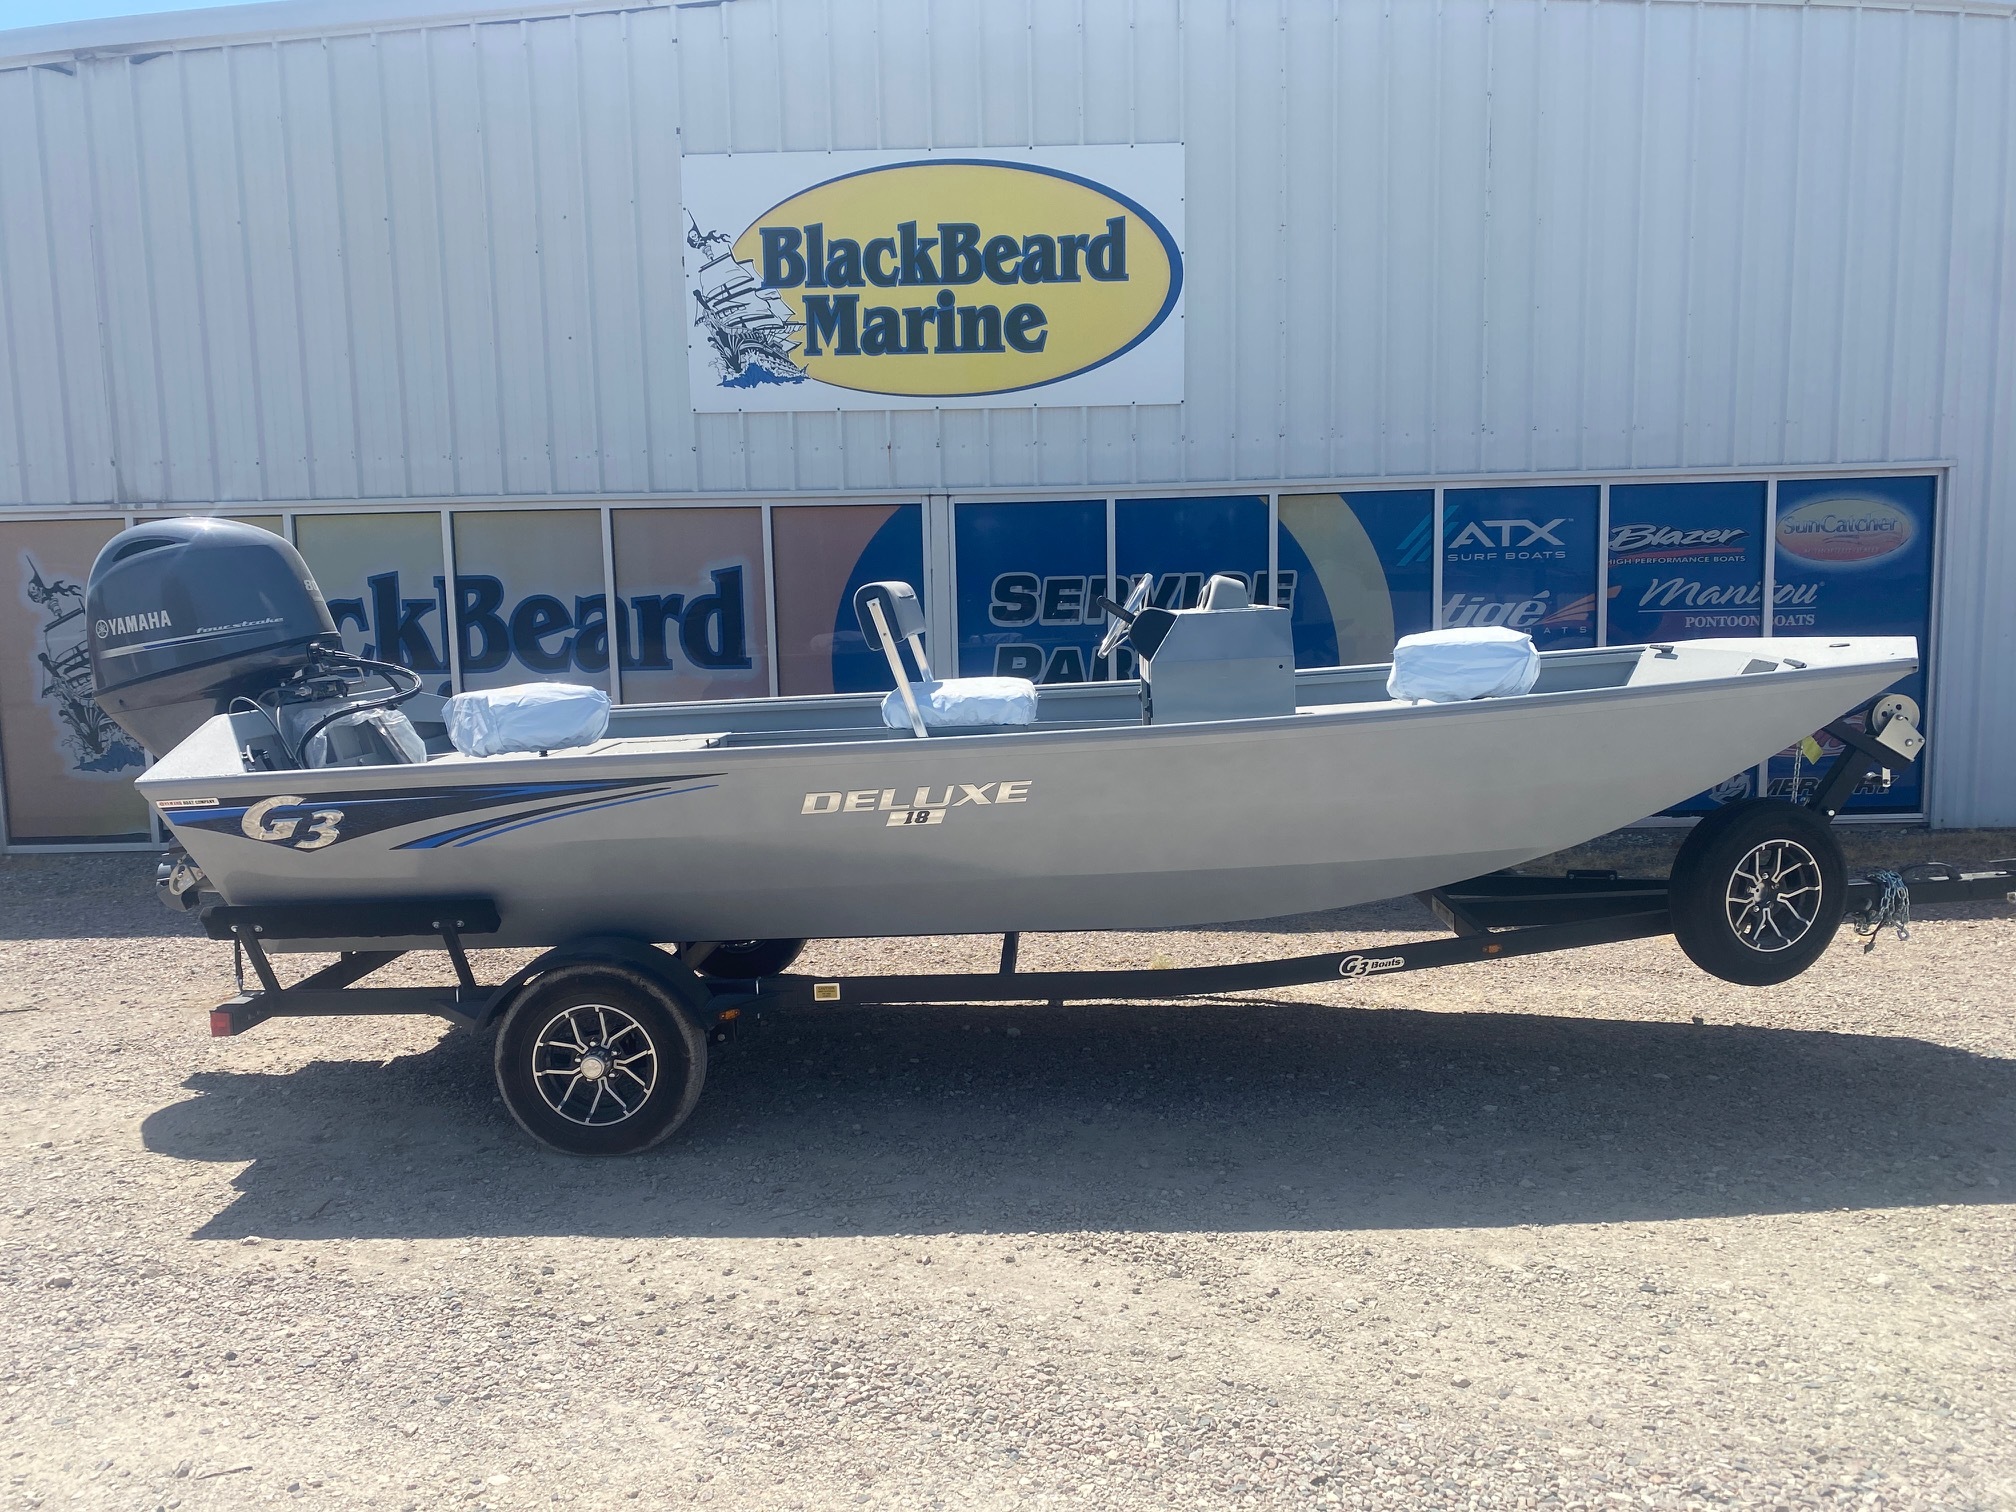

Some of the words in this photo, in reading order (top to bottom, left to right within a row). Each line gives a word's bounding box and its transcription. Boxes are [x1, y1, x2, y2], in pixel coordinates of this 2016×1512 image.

[758, 215, 1130, 289] BlackBeard
[801, 288, 1049, 357] Marine
[1447, 518, 1567, 549] ATX
[1608, 524, 1747, 551] Blazer
[1783, 512, 1898, 535] SunCatcher
[1447, 552, 1498, 562] SURF
[1505, 551, 1566, 560] BOATS
[1634, 556, 1710, 565] PERFORMANCE
[1713, 555, 1746, 563] BOATS
[988, 570, 1298, 627] SERVIE
[1638, 577, 1818, 607] Maniou
[107, 610, 172, 636] YAMAHA
[328, 565, 753, 677] ckBeard
[1685, 615, 1761, 628] PONTOON
[1771, 614, 1815, 626] OATS
[801, 780, 1033, 814] DELUXE
[241, 795, 345, 849] G3
[903, 810, 931, 824] 18
[1340, 956, 1369, 976] G3
[1371, 959, 1401, 969] Boats
